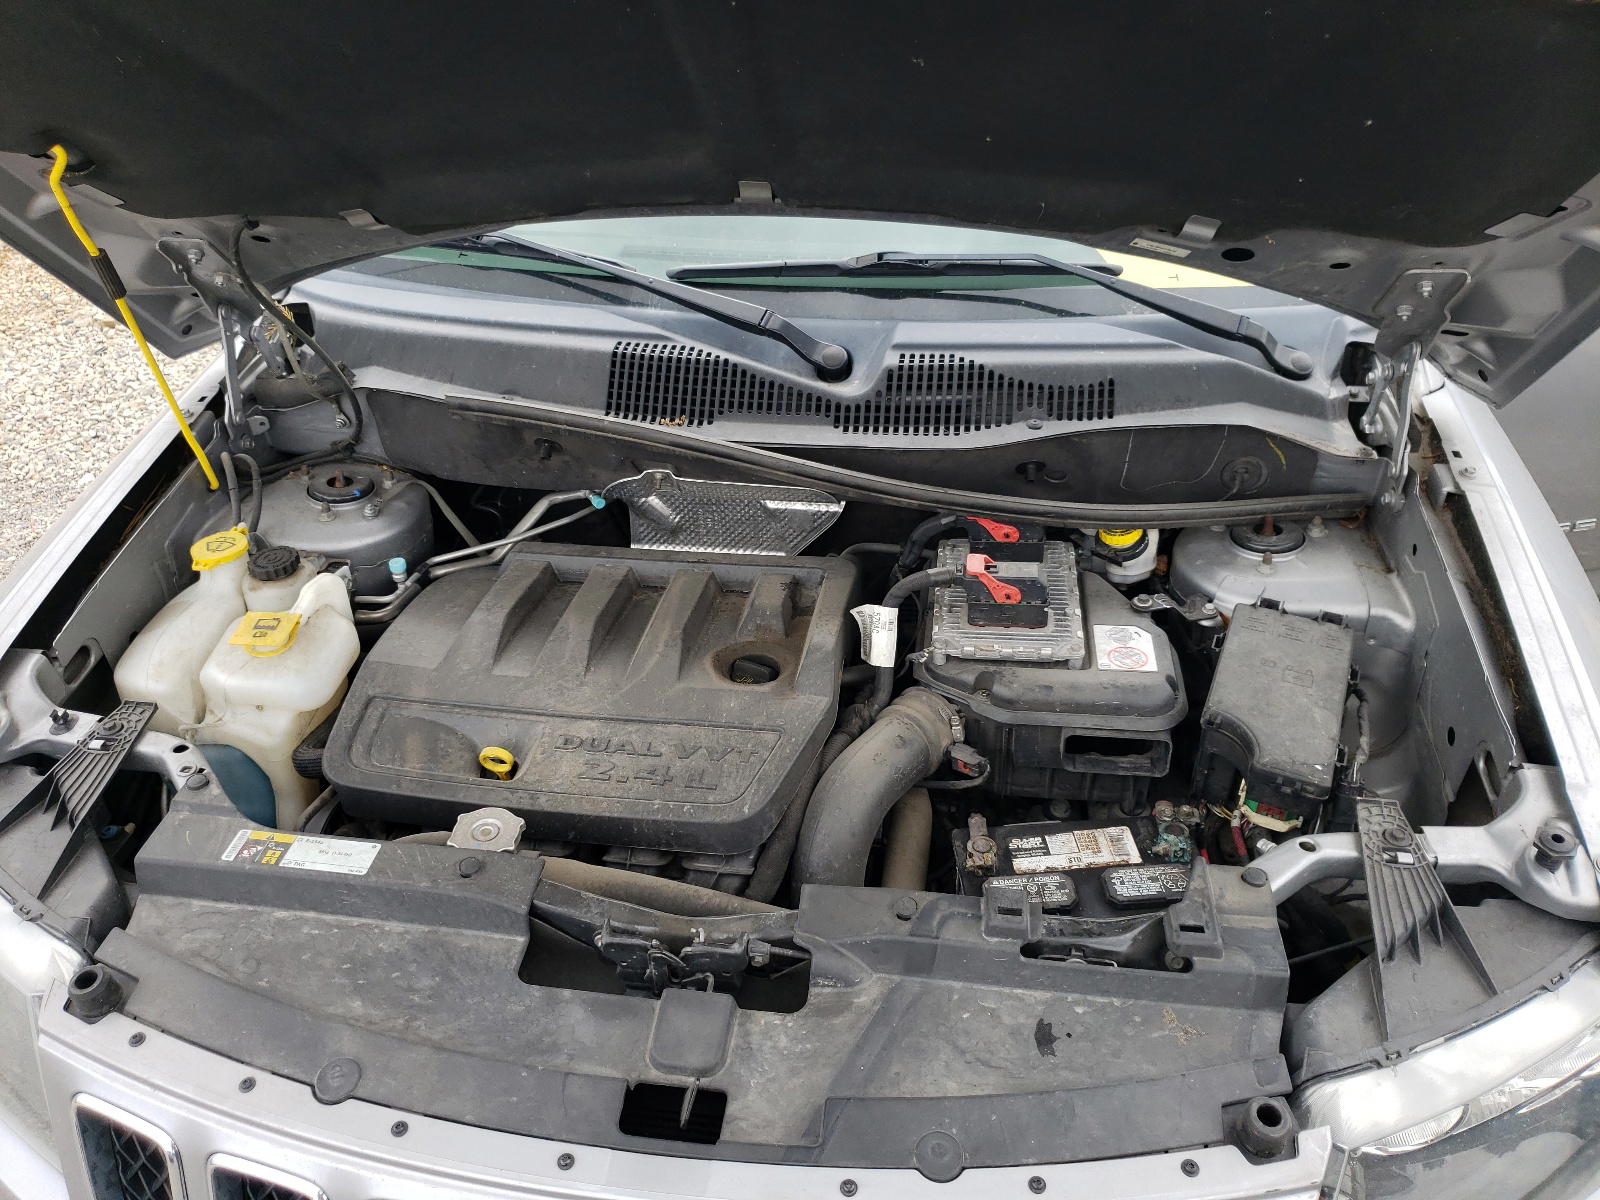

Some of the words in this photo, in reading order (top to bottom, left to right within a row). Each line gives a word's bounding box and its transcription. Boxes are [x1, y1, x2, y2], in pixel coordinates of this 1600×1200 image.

[554, 734, 662, 757] DUAL
[673, 742, 759, 763] VVT
[577, 759, 718, 791] 2.4L
